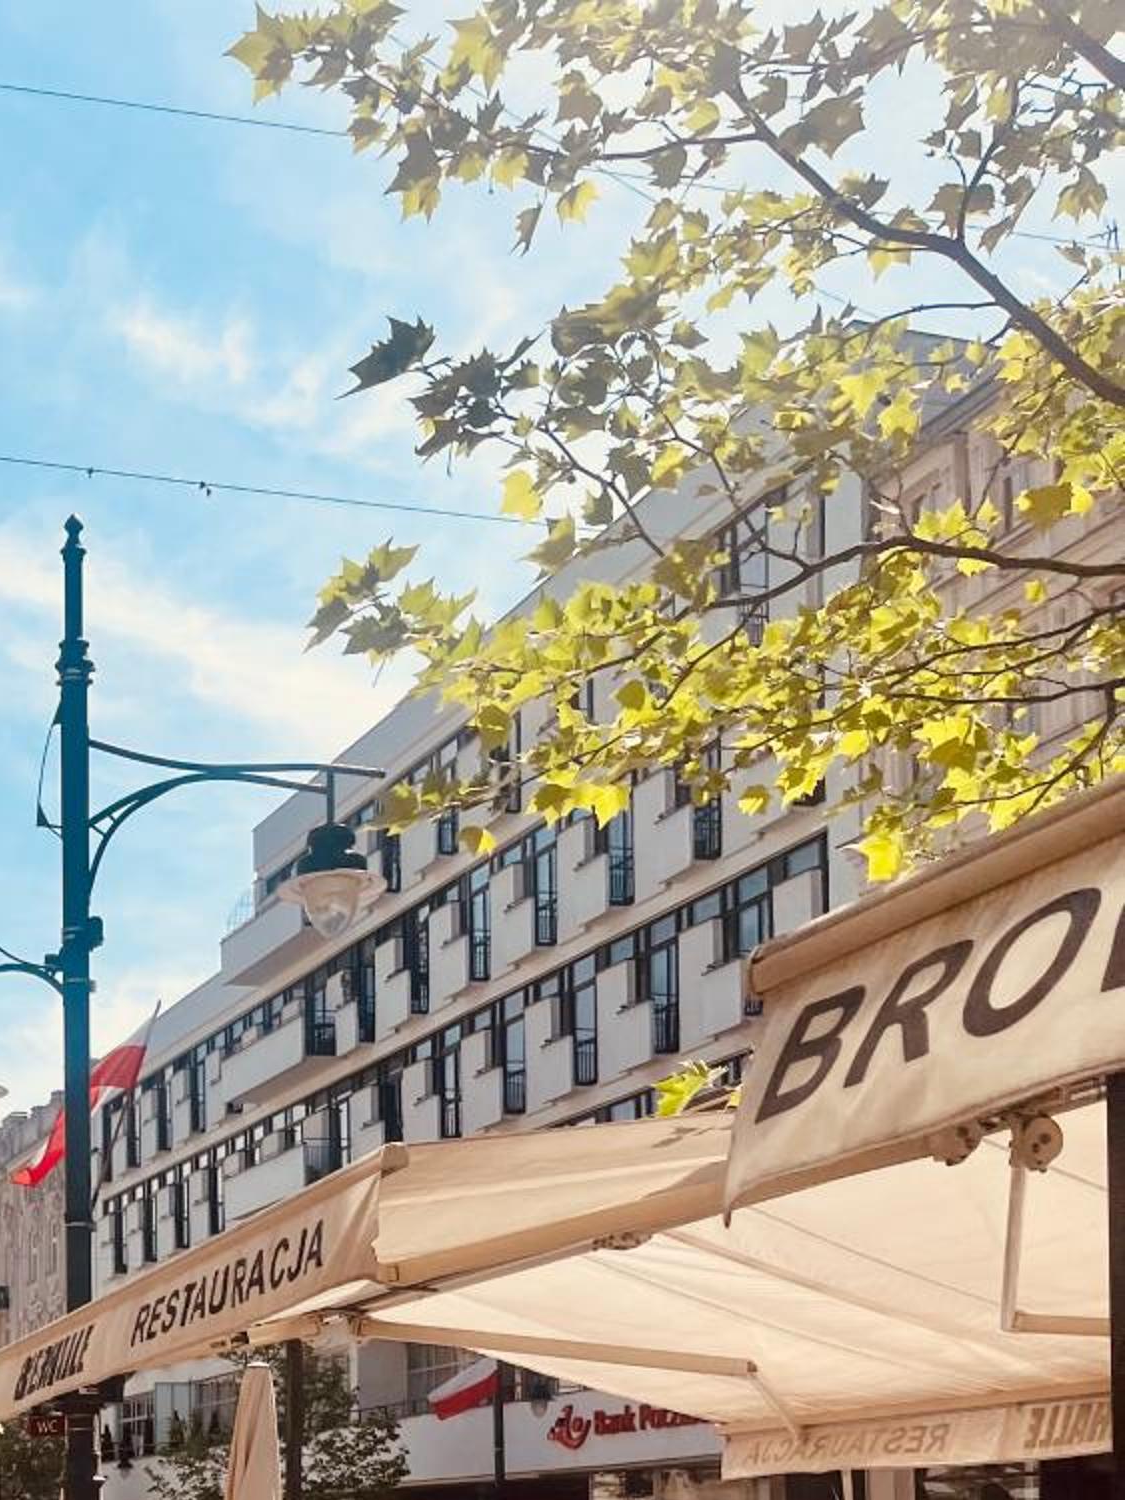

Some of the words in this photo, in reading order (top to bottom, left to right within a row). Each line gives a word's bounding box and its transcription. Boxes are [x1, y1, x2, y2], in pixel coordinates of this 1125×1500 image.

[754, 887, 1125, 1125] BRO
[131, 1219, 324, 1347] RESTAURACJA
[35, 1419, 58, 1434] WC
